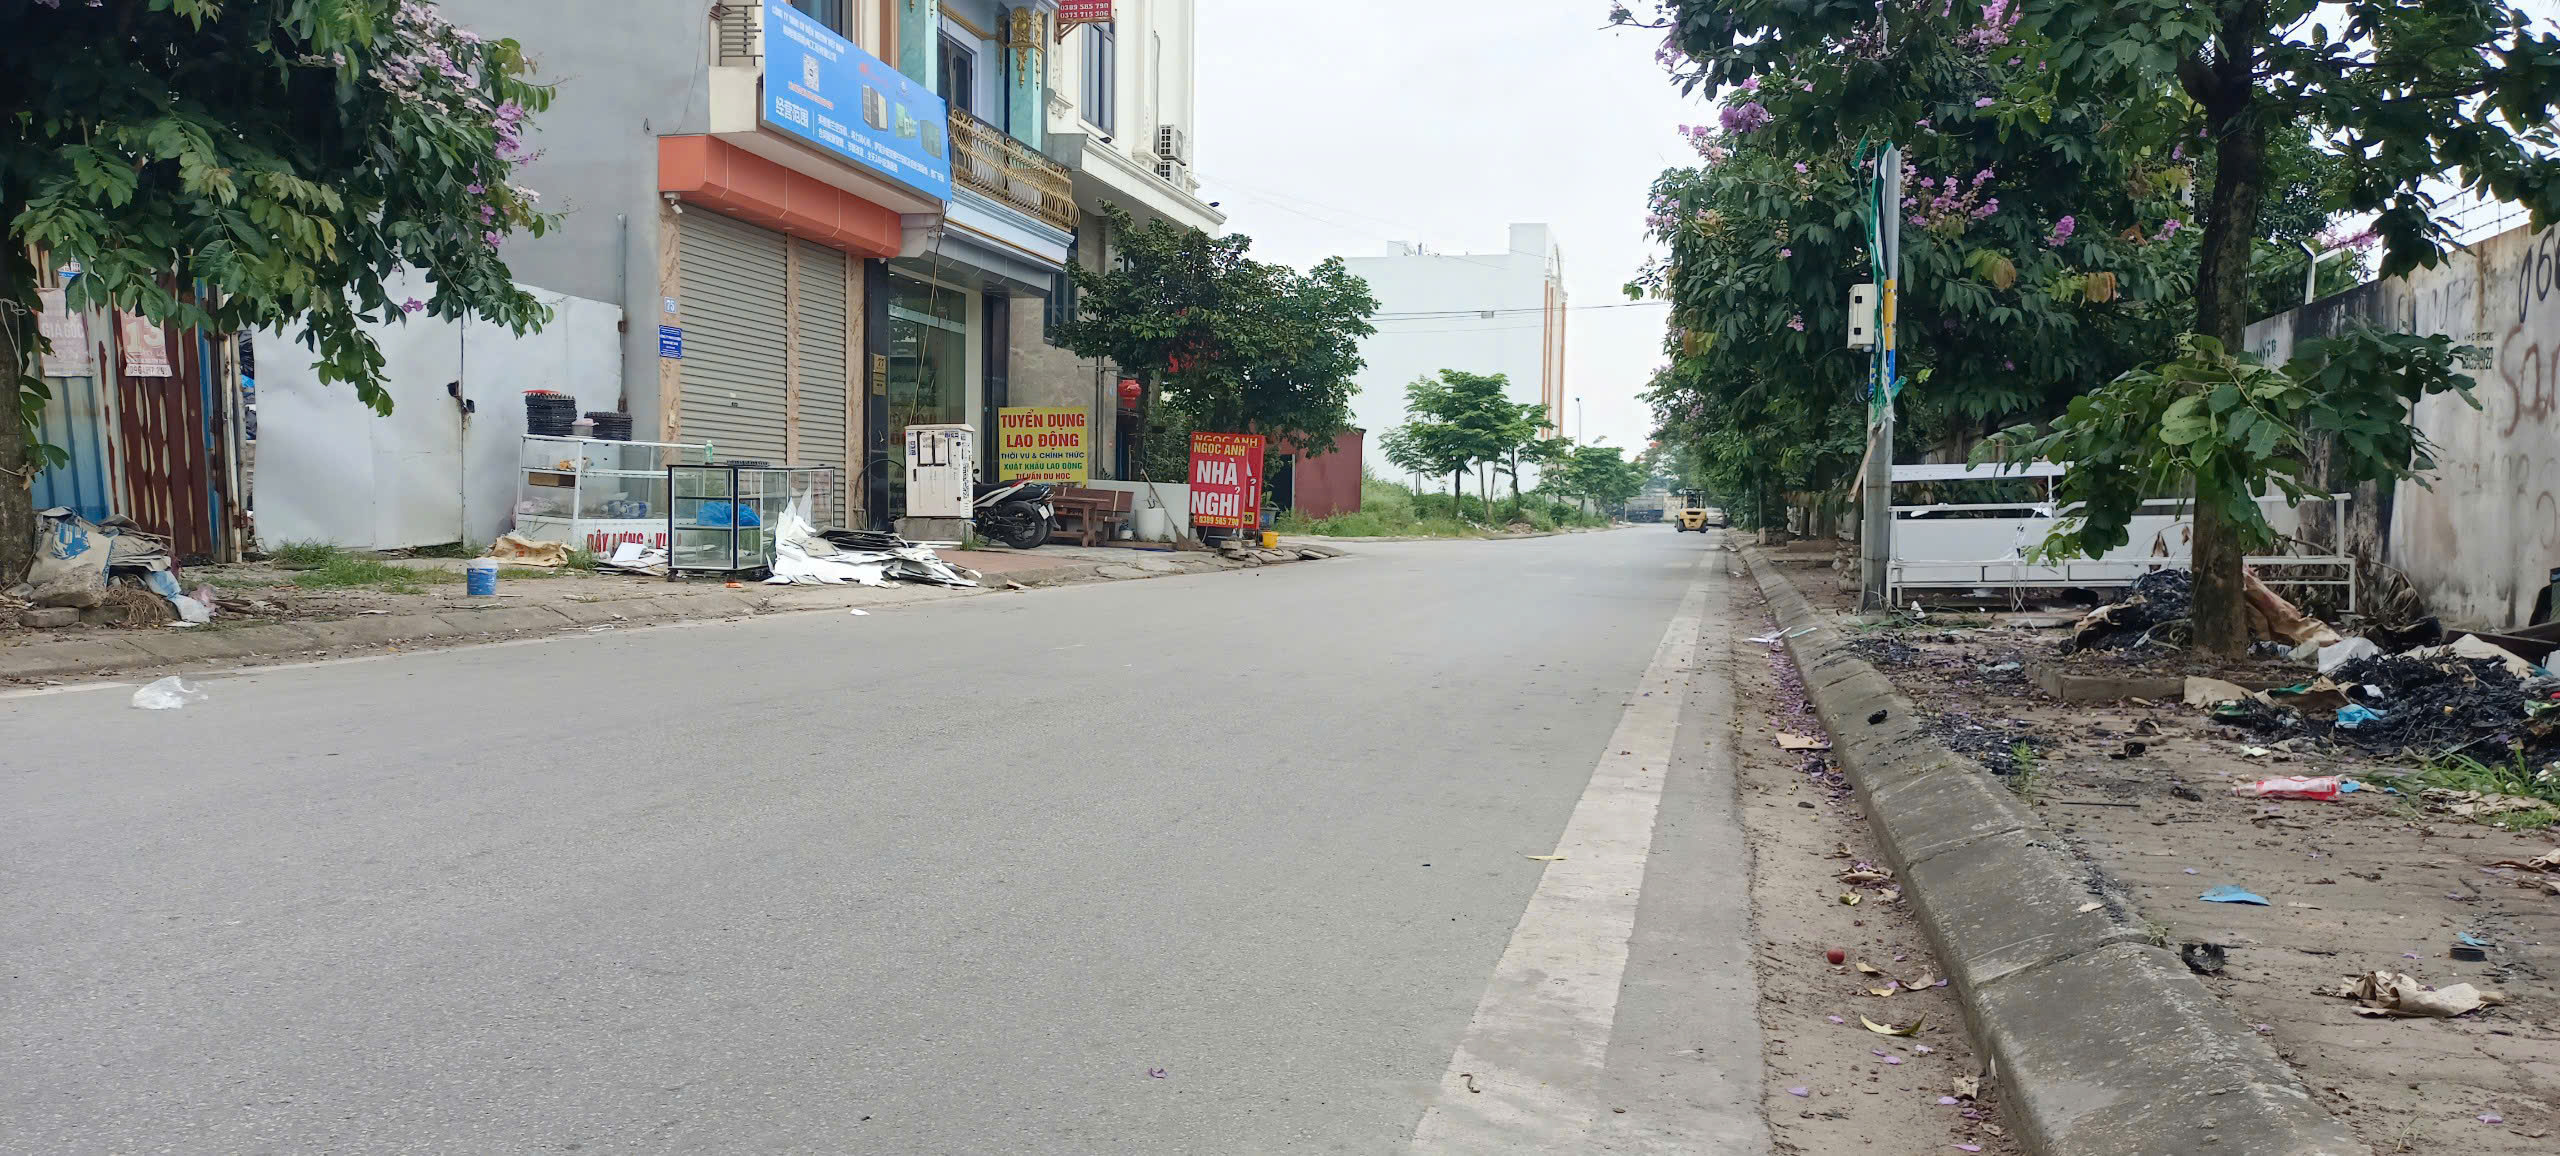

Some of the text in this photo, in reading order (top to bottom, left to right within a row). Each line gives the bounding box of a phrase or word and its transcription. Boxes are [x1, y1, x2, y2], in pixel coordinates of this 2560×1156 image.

[666, 299, 676, 312] 75
[1001, 409, 1085, 430] TUYỂN DỤNG
[1006, 431, 1079, 450] LAO ĐỘNG
[1193, 442, 1246, 456] NGỌC ANH
[1039, 451, 1063, 459] CHÍNH
[1065, 451, 1085, 459] THỨC
[1196, 457, 1238, 486] NHÀ
[1191, 486, 1241, 517] NGHỈ
[586, 528, 609, 553] DÂY
